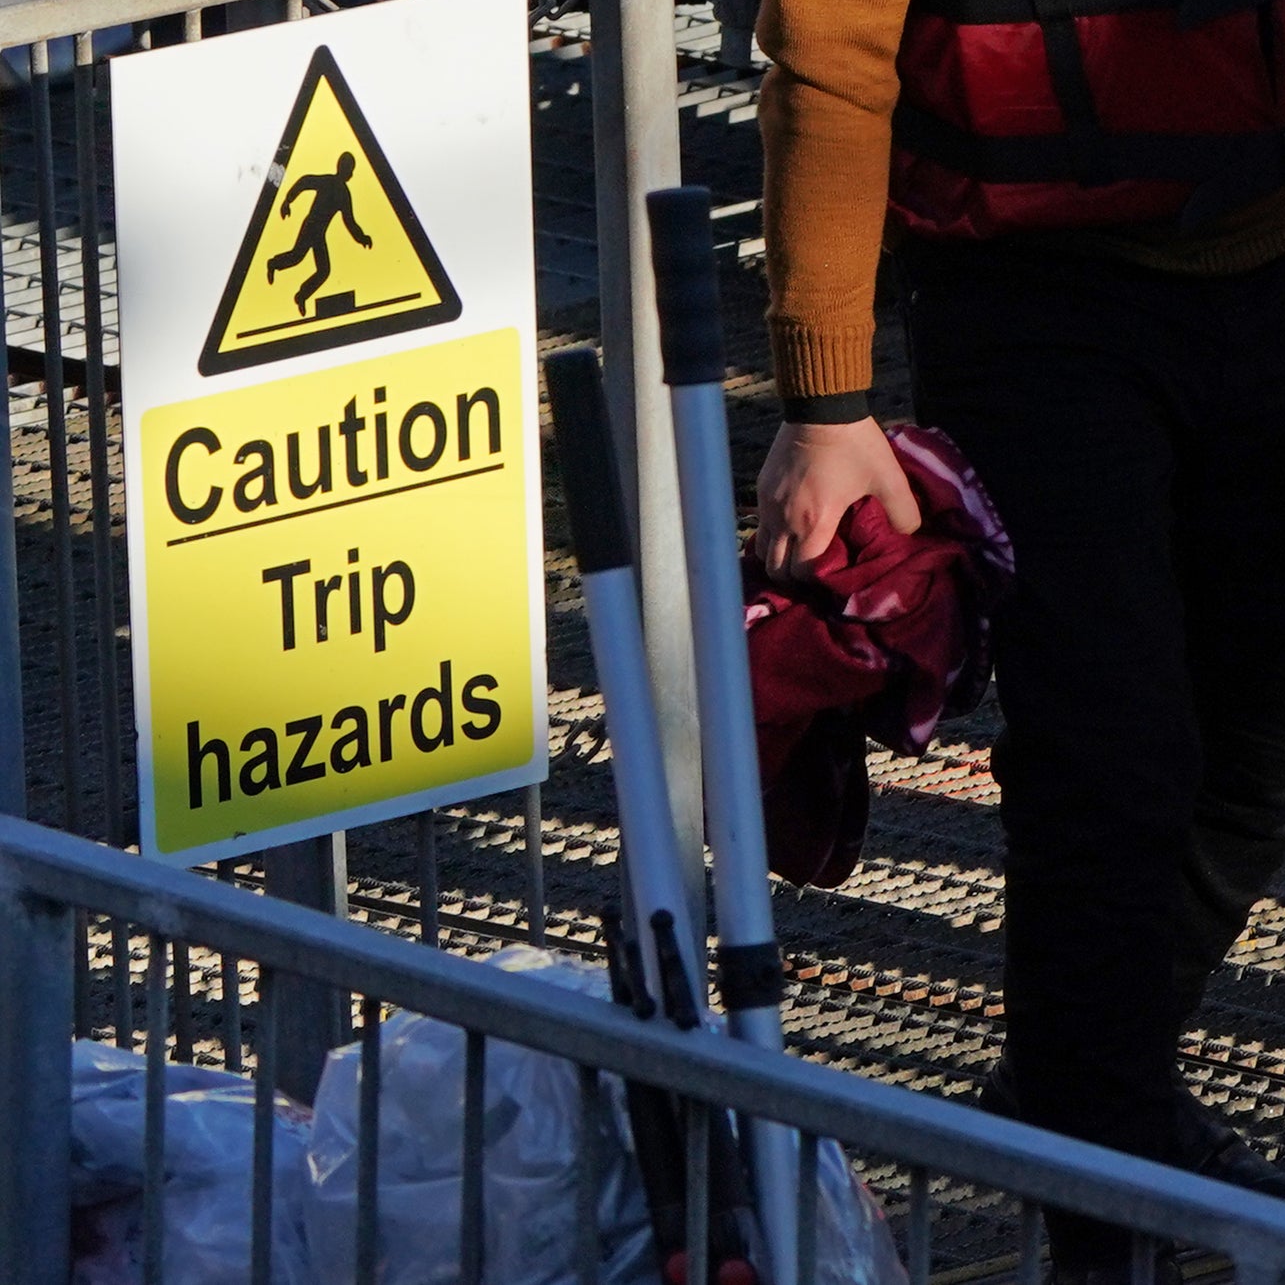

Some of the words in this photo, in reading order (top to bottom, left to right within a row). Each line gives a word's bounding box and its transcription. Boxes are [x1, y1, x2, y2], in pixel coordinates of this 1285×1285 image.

[165, 386, 502, 526] Caution
[262, 546, 416, 653] Trip
[186, 659, 502, 810] hazards
